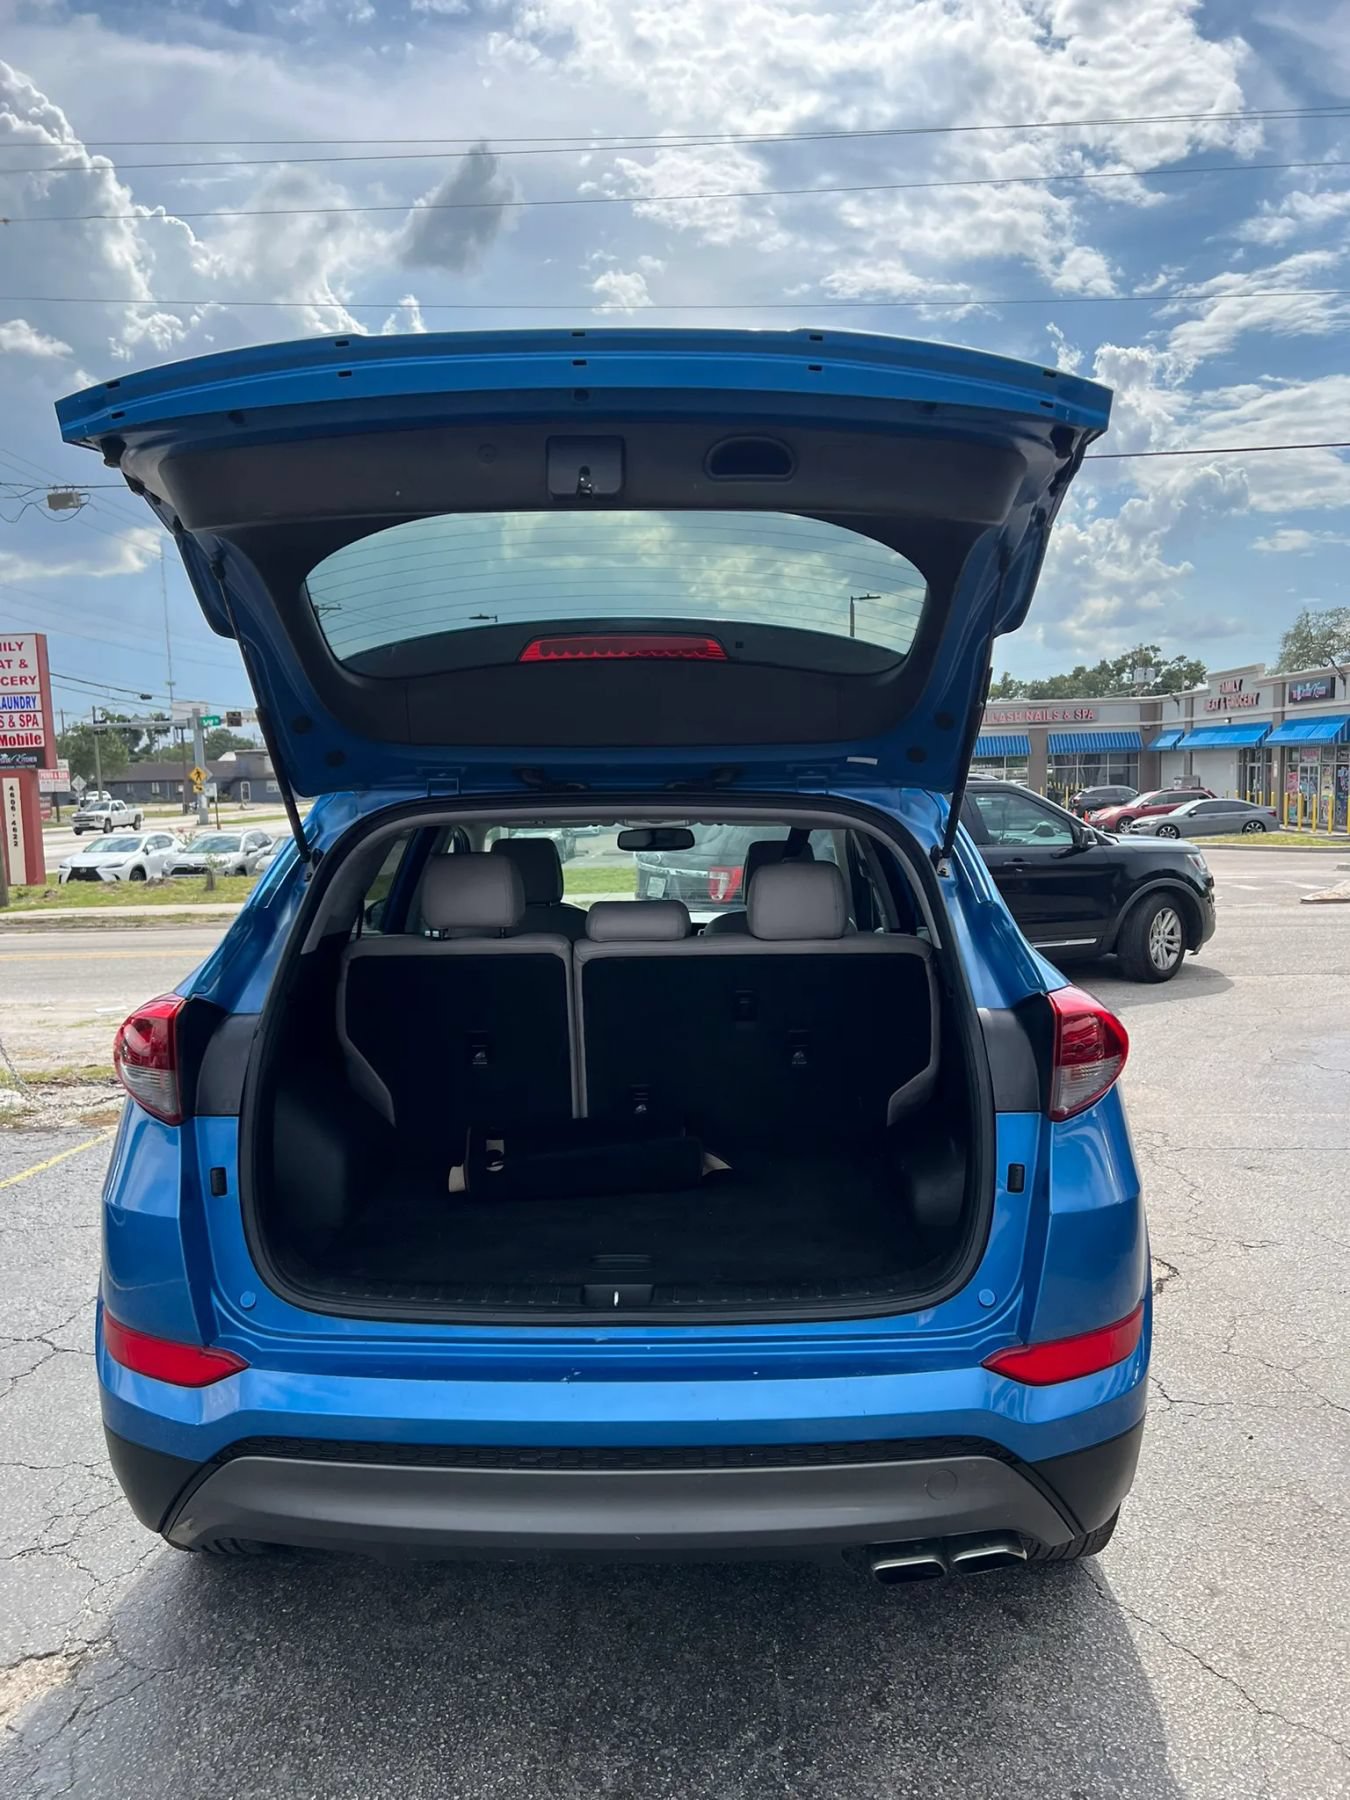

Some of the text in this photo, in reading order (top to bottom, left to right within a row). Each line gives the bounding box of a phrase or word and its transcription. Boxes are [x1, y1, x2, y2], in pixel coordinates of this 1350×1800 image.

[0, 641, 24, 652] ILY
[19, 658, 28, 669] &
[0, 675, 37, 686] CERY
[8, 715, 16, 728] &
[19, 714, 39, 728] SPA
[991, 711, 1023, 723] LASH
[1025, 709, 1060, 721] NAILS
[1063, 710, 1071, 721] &
[1074, 708, 1095, 720] SPA
